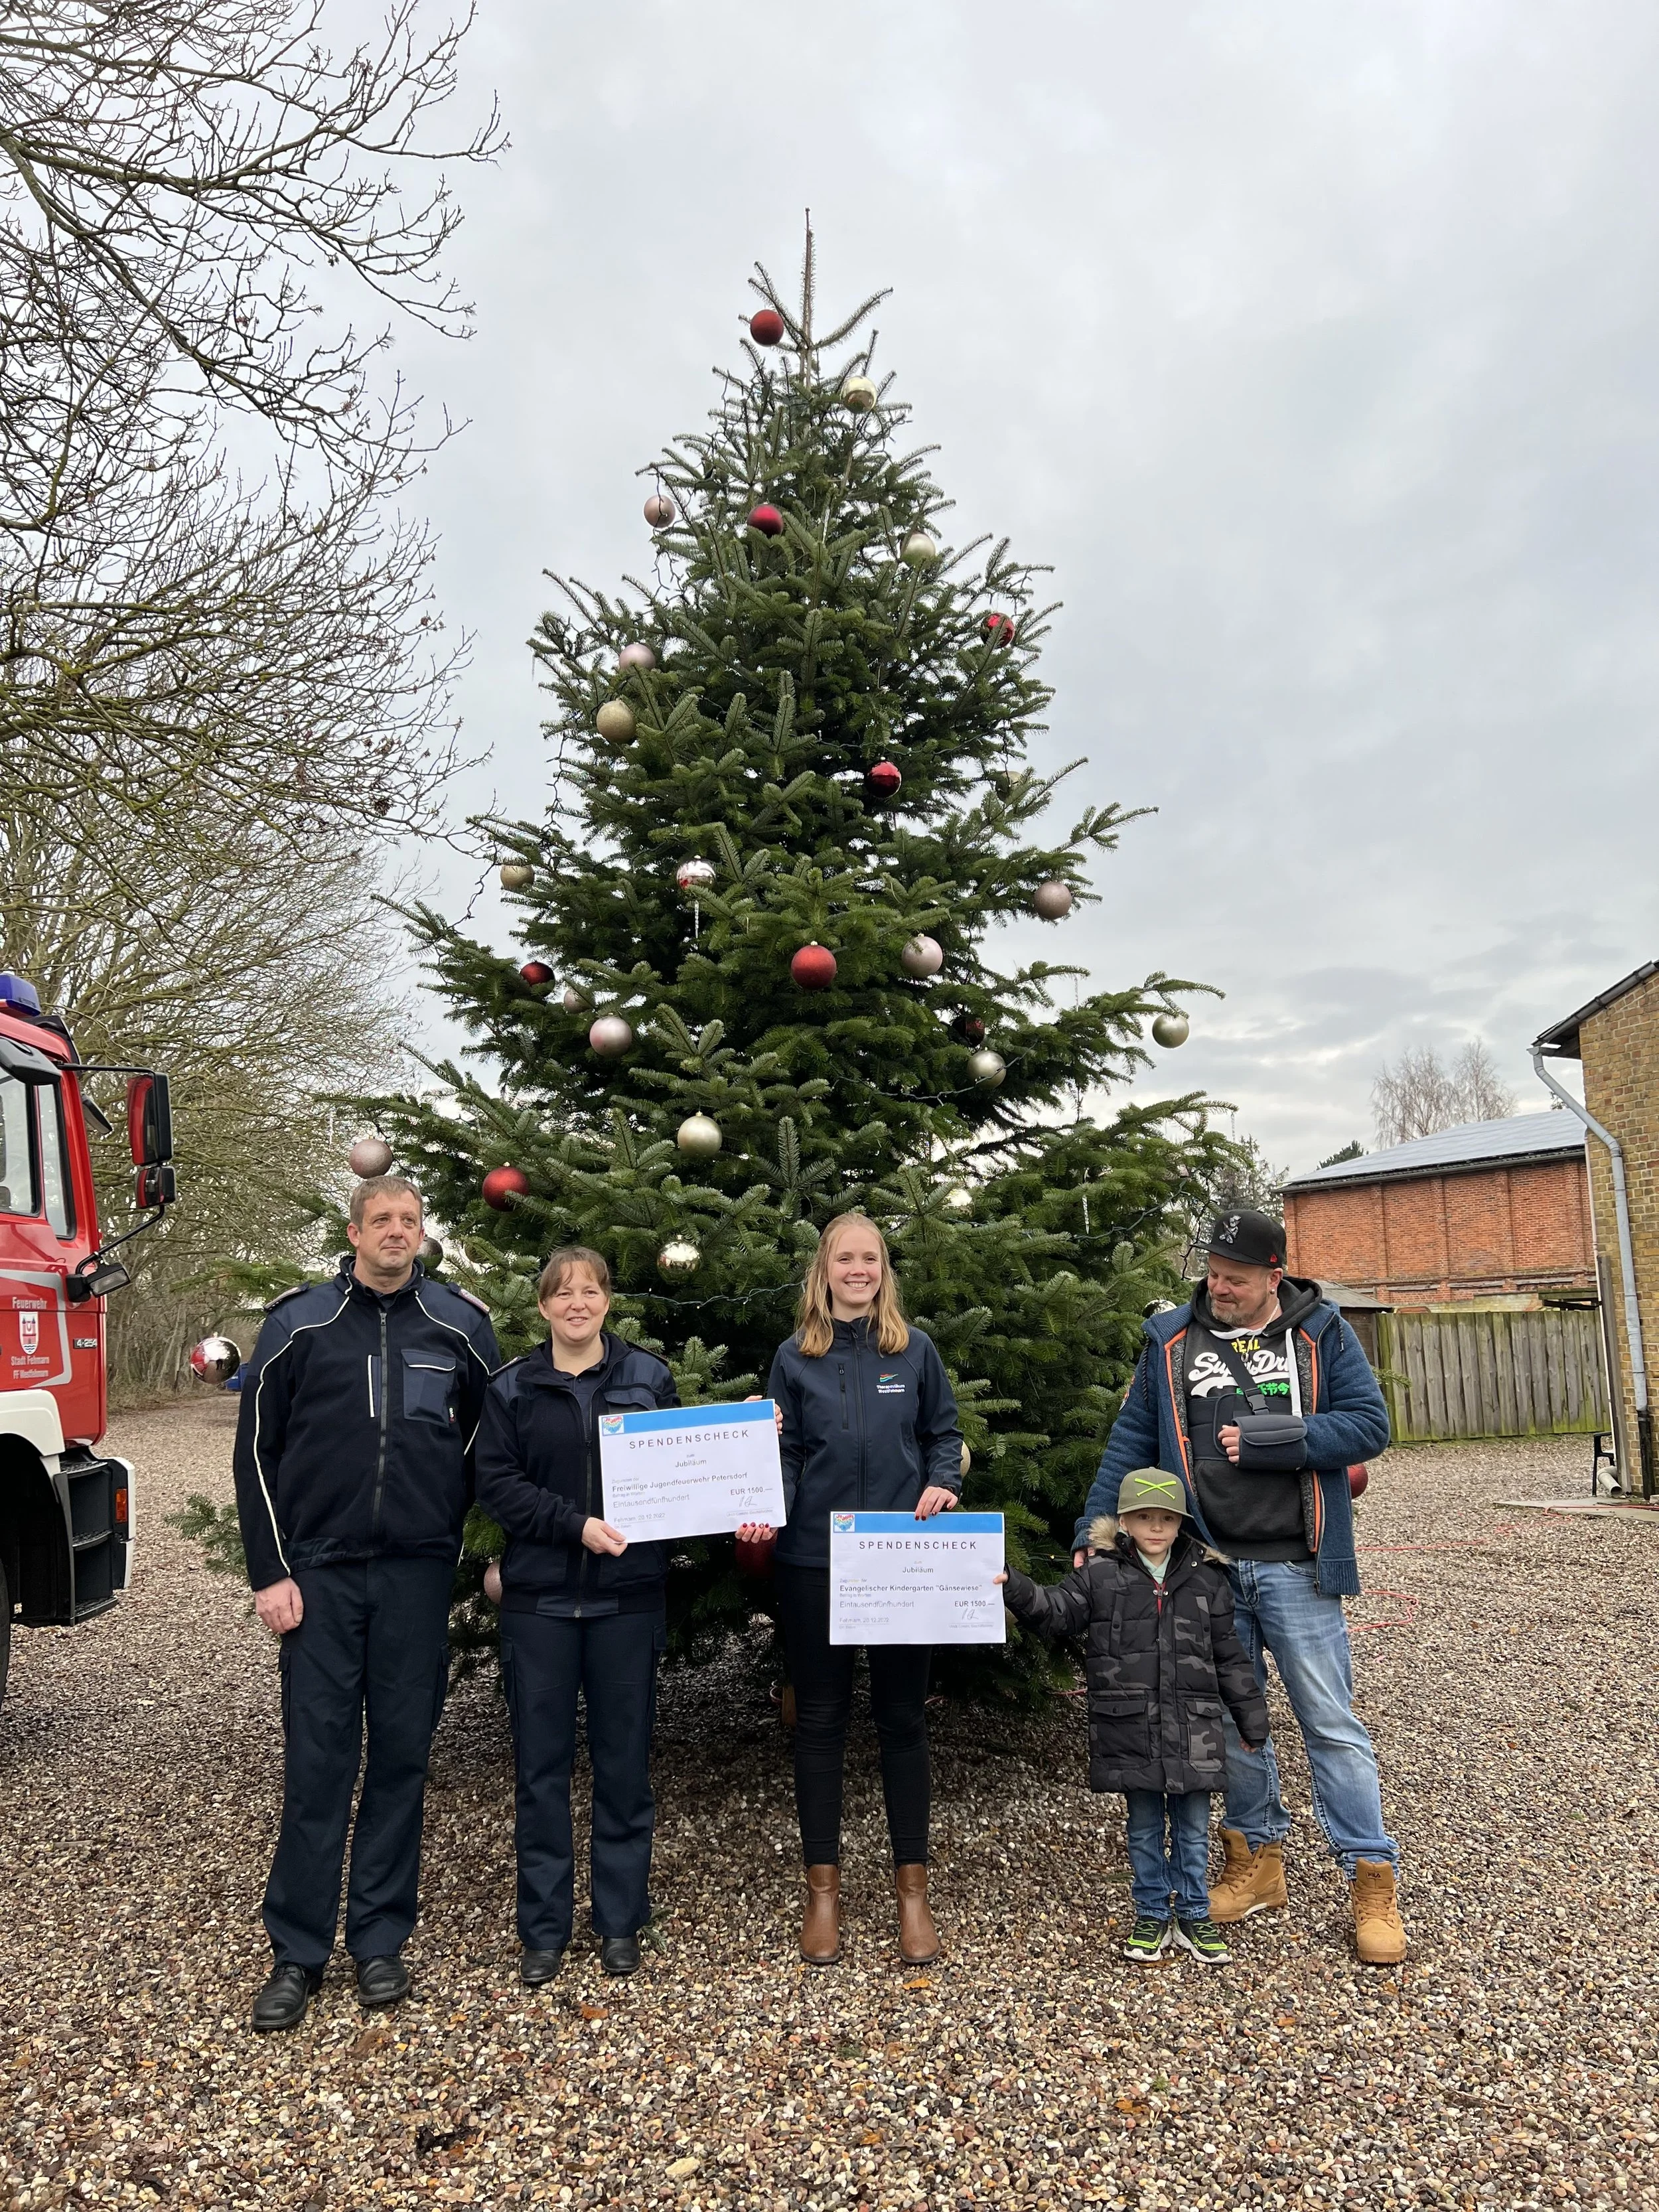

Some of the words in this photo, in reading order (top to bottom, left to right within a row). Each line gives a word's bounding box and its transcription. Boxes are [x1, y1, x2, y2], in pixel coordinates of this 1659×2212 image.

[12, 1296, 48, 1309] Feuerwehr
[1231, 1339, 1261, 1353] REAL
[11, 1356, 27, 1366] Stadt
[27, 1355, 50, 1364] Fehmarn
[629, 1430, 749, 1449] SPENDENSCHECK
[675, 1459, 707, 1467] Jubiläum
[612, 1483, 648, 1493] Freiwillige
[650, 1476, 710, 1489] Jugendfeuerwehr
[711, 1472, 748, 1481] Petersdorf
[613, 1494, 690, 1509] Eintausendfünfhundert
[859, 1541, 977, 1550] SPENDENSCHECK
